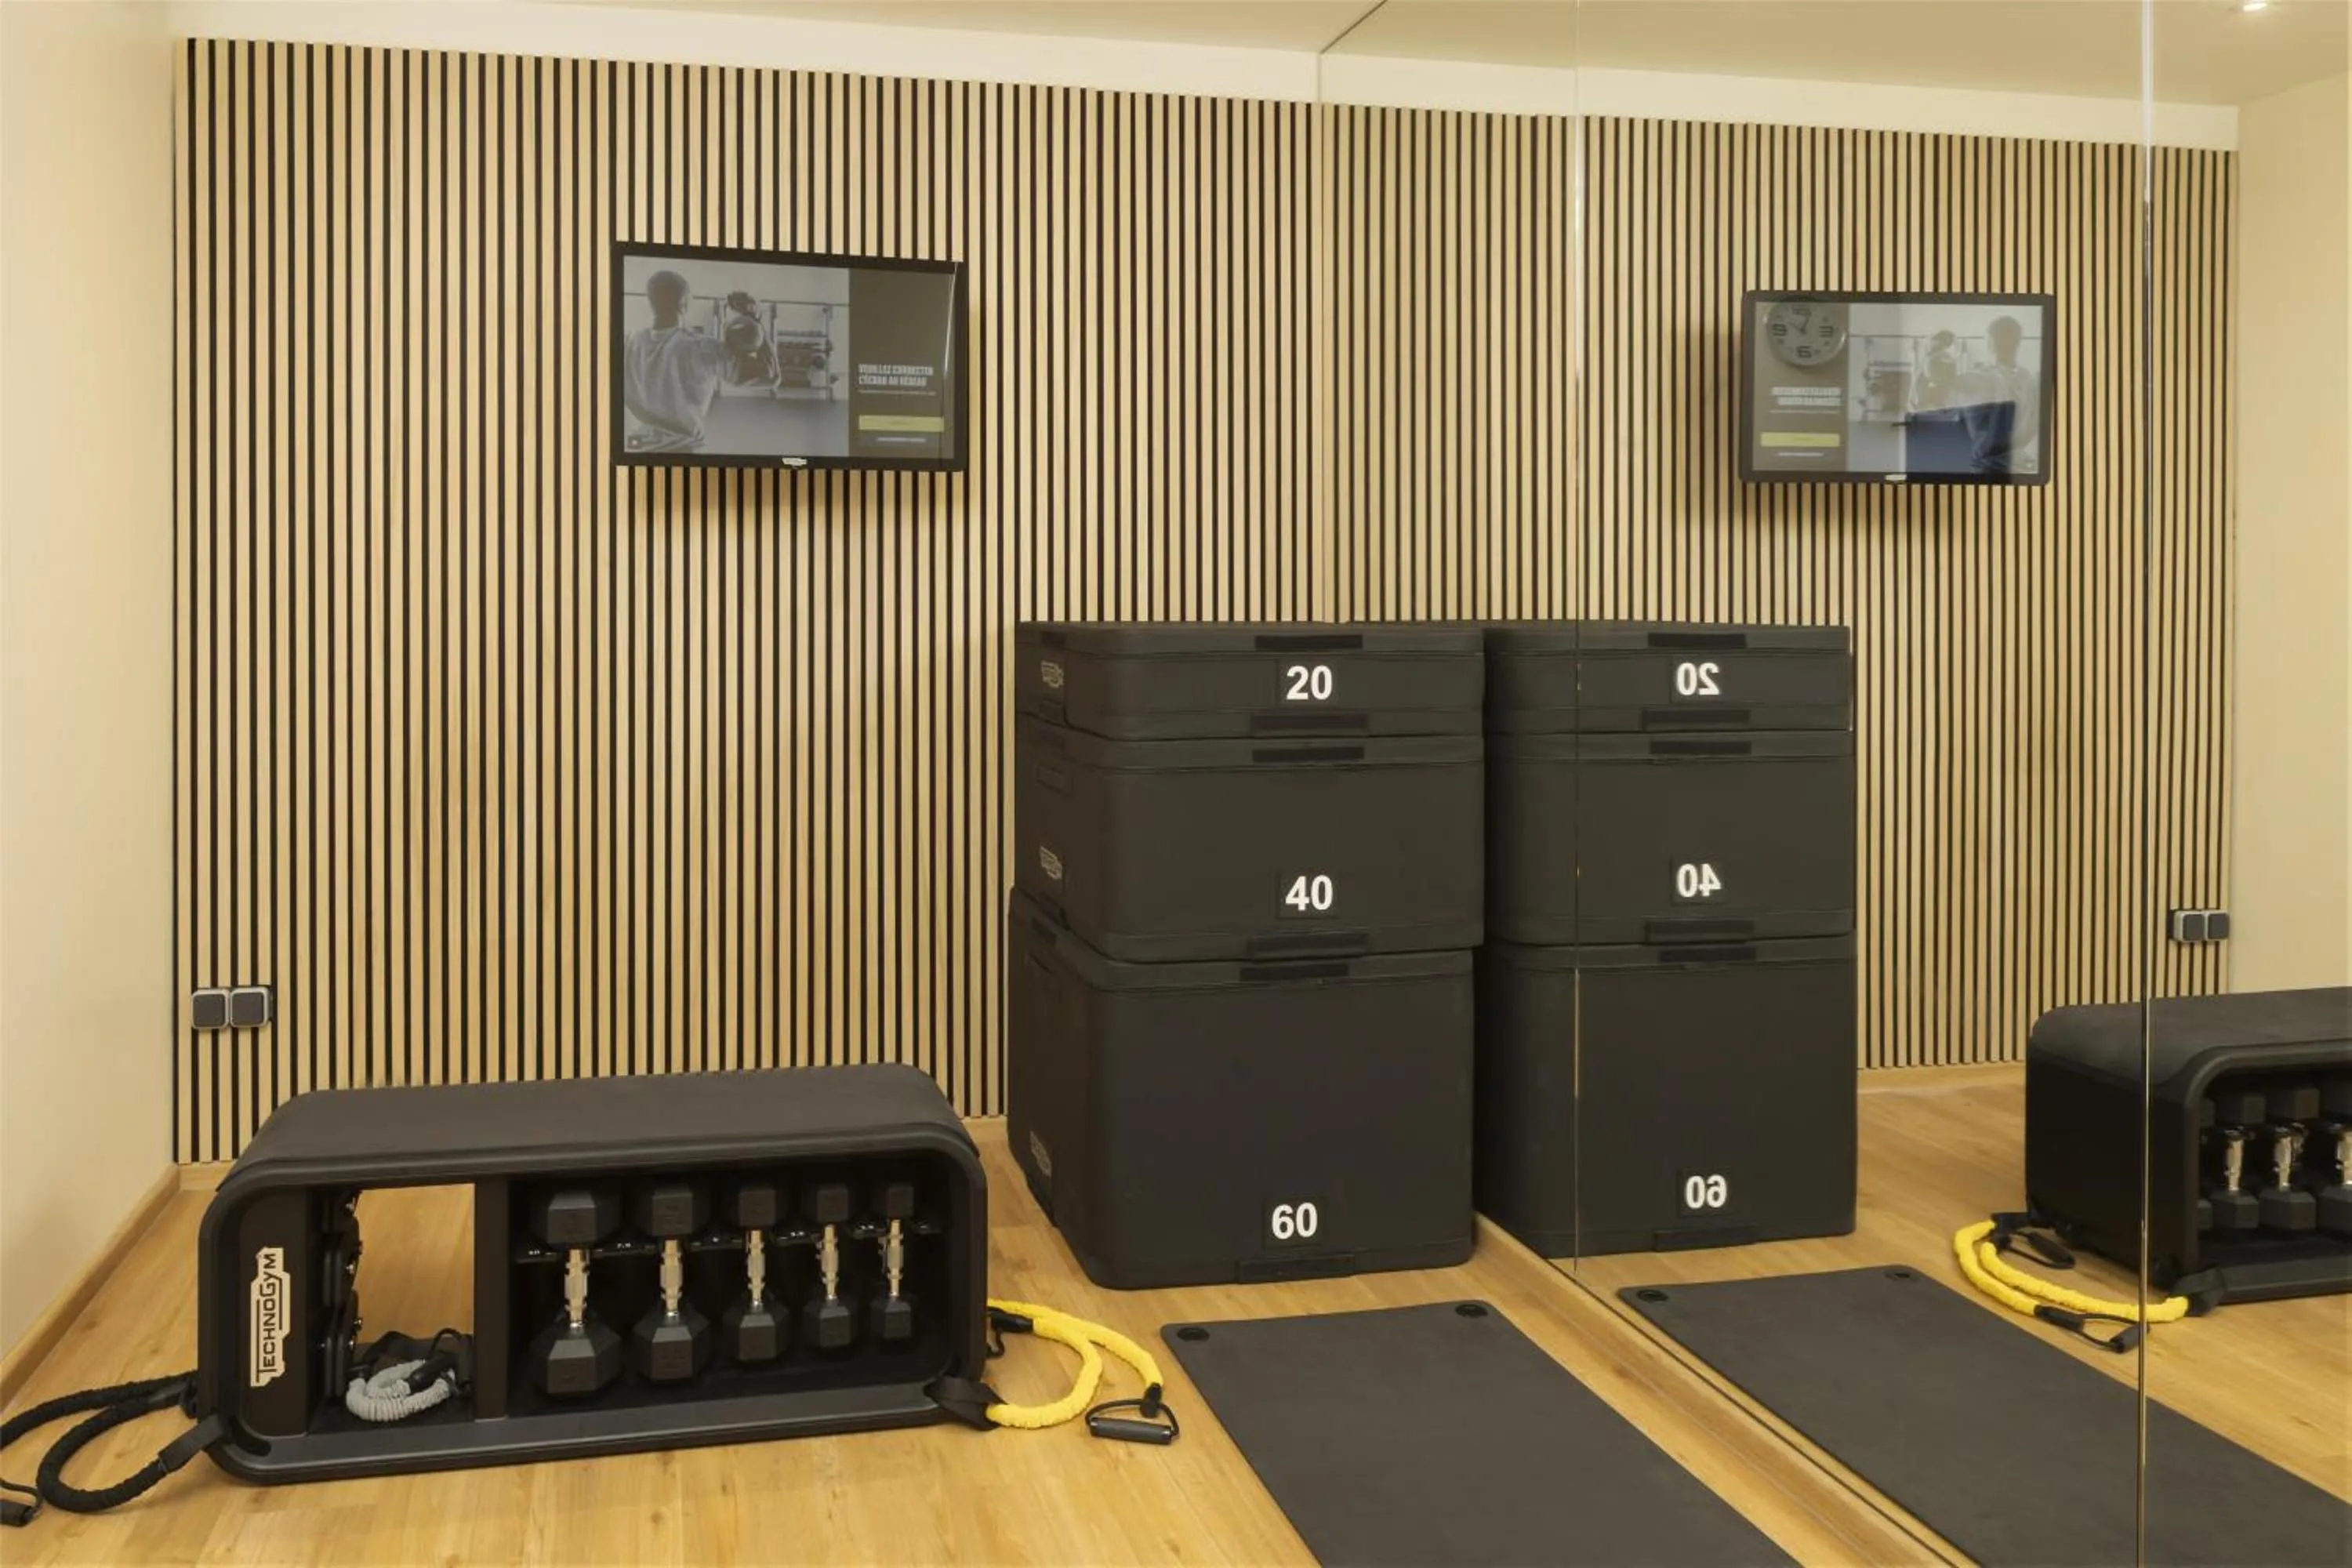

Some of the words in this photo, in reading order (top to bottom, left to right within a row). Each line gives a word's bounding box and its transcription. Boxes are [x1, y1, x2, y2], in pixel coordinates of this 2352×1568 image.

[1286, 665, 1333, 701] 20
[1286, 875, 1333, 911] 40
[1272, 1203, 1318, 1239] 60
[255, 1252, 284, 1384] TECHNOGYM
